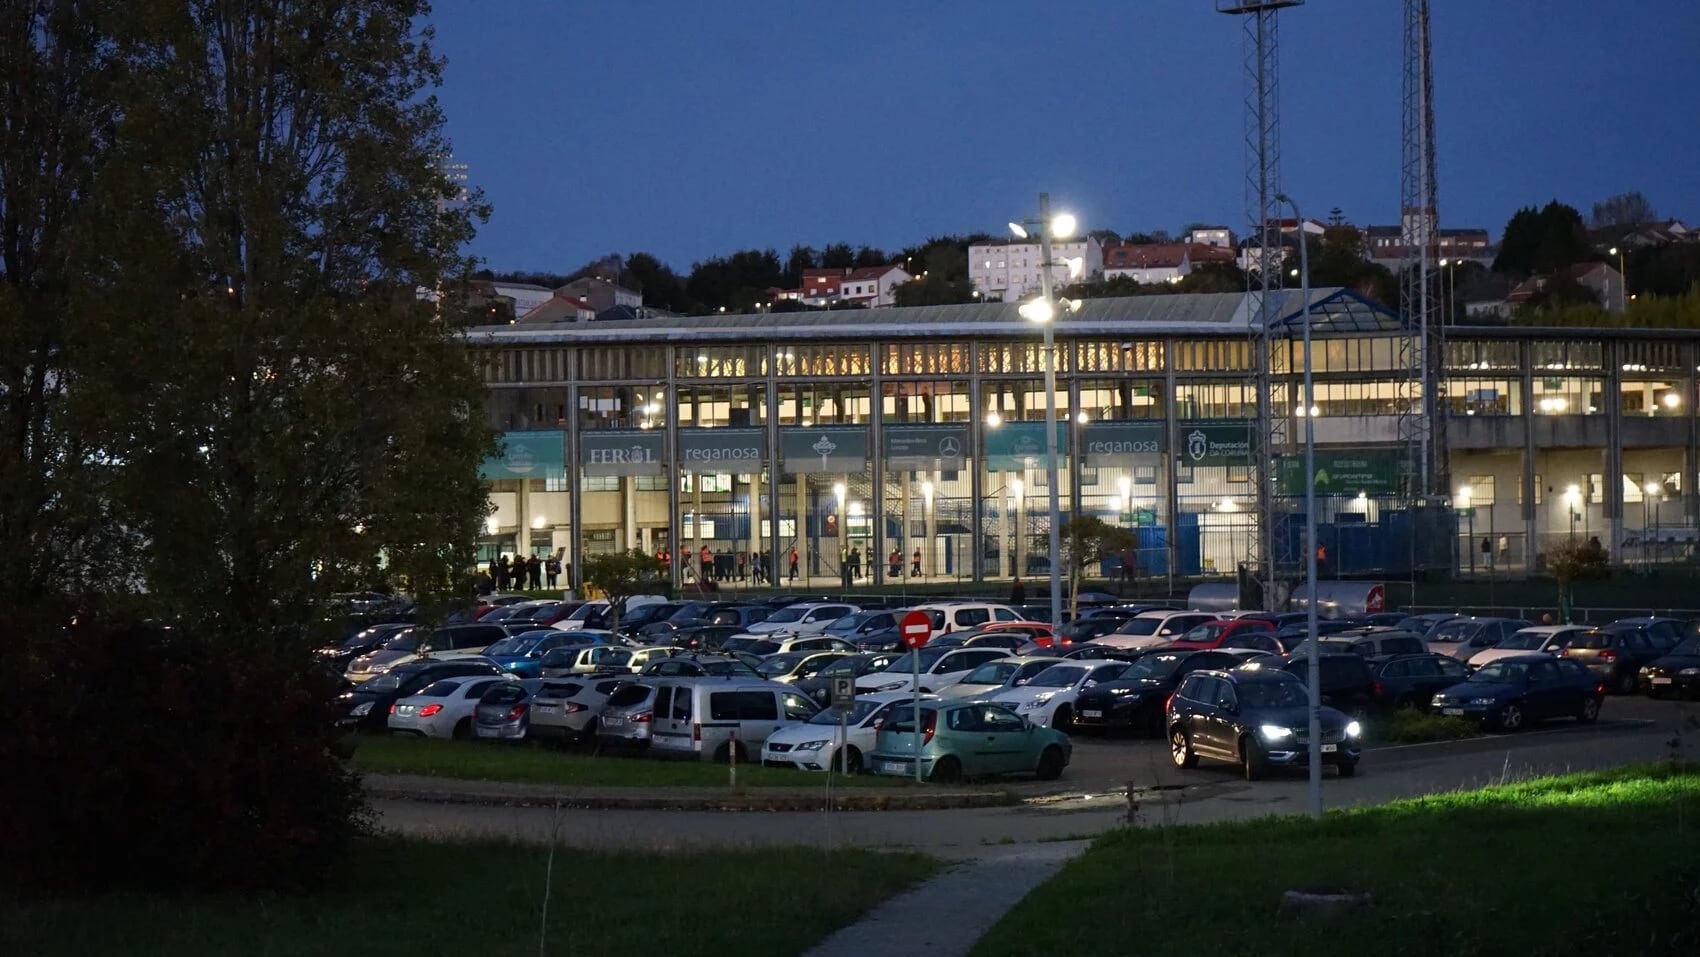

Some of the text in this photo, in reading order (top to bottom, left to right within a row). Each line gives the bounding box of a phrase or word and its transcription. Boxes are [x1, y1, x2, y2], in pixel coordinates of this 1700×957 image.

[591, 446, 657, 464] FERROL
[685, 447, 759, 463] reganosa
[1088, 440, 1159, 456] reganosa
[838, 680, 849, 693] P
